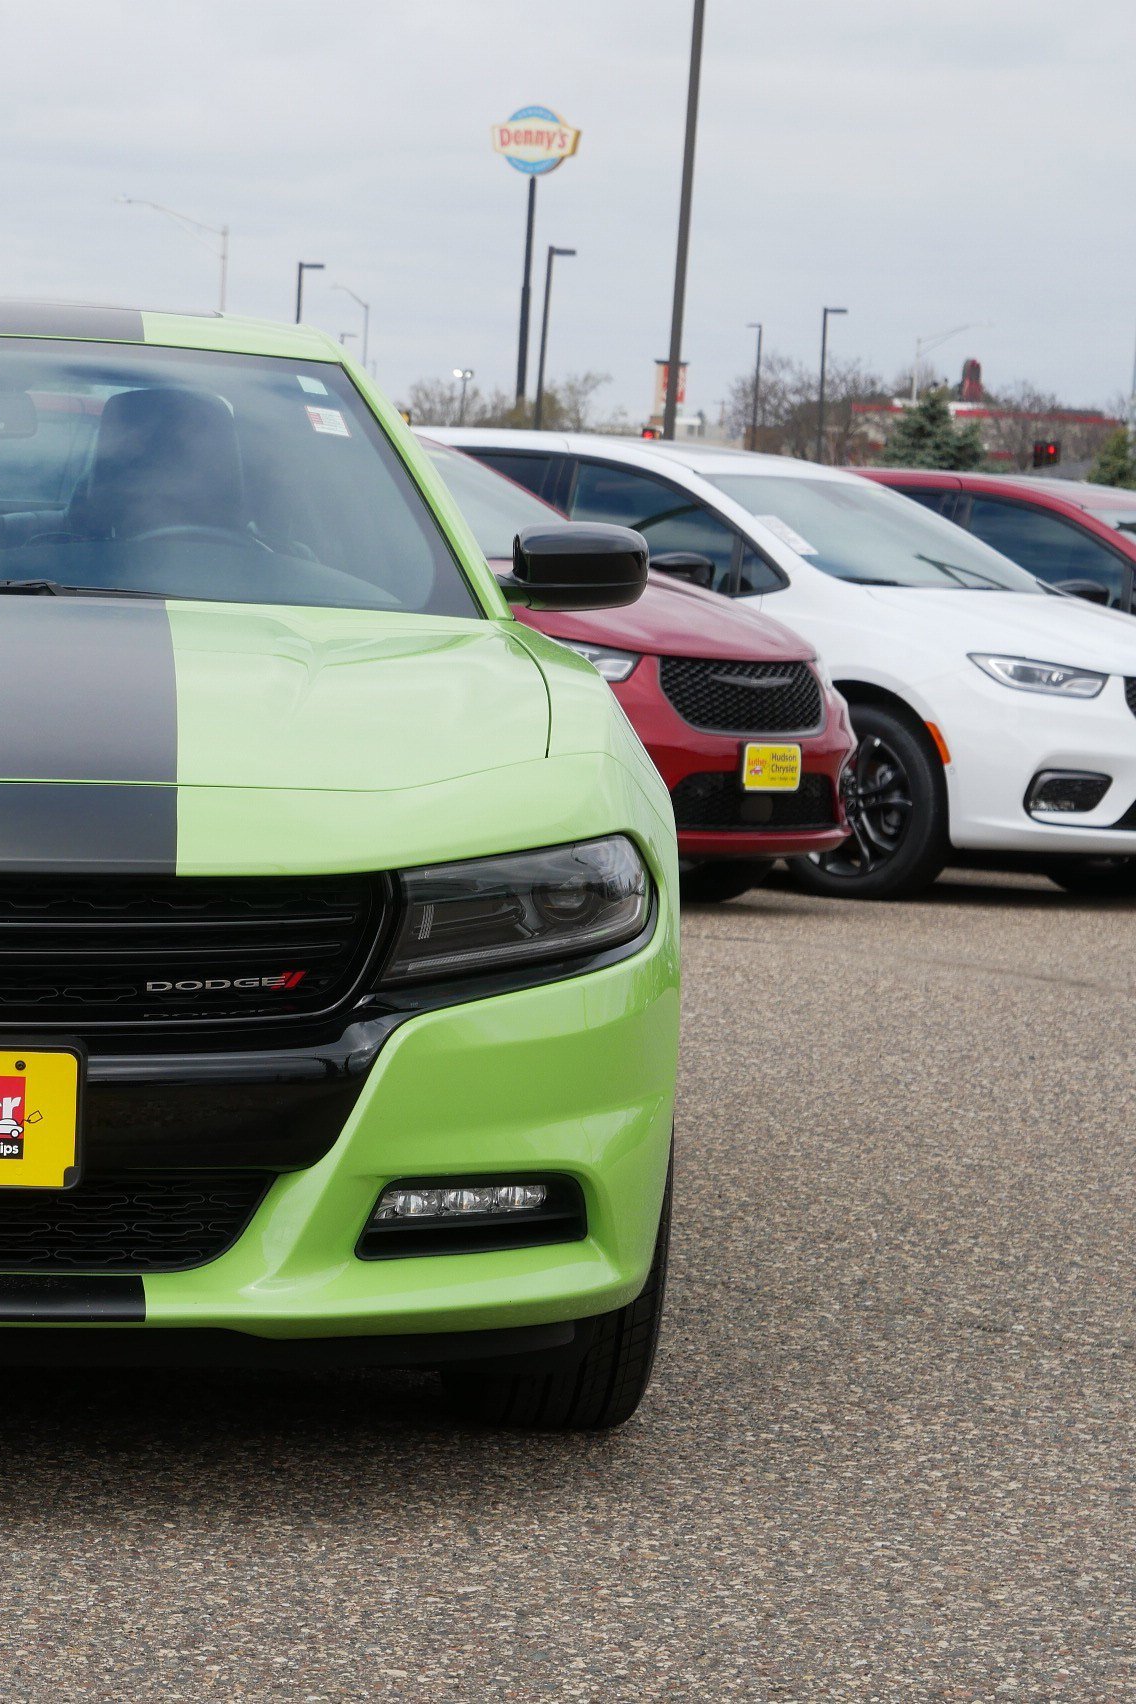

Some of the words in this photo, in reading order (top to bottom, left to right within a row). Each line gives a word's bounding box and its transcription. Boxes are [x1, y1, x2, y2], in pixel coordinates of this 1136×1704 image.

[499, 127, 569, 151] Denny's
[771, 753, 797, 762] Hudson
[771, 763, 797, 775] Chrysler
[146, 976, 286, 992] DODGE
